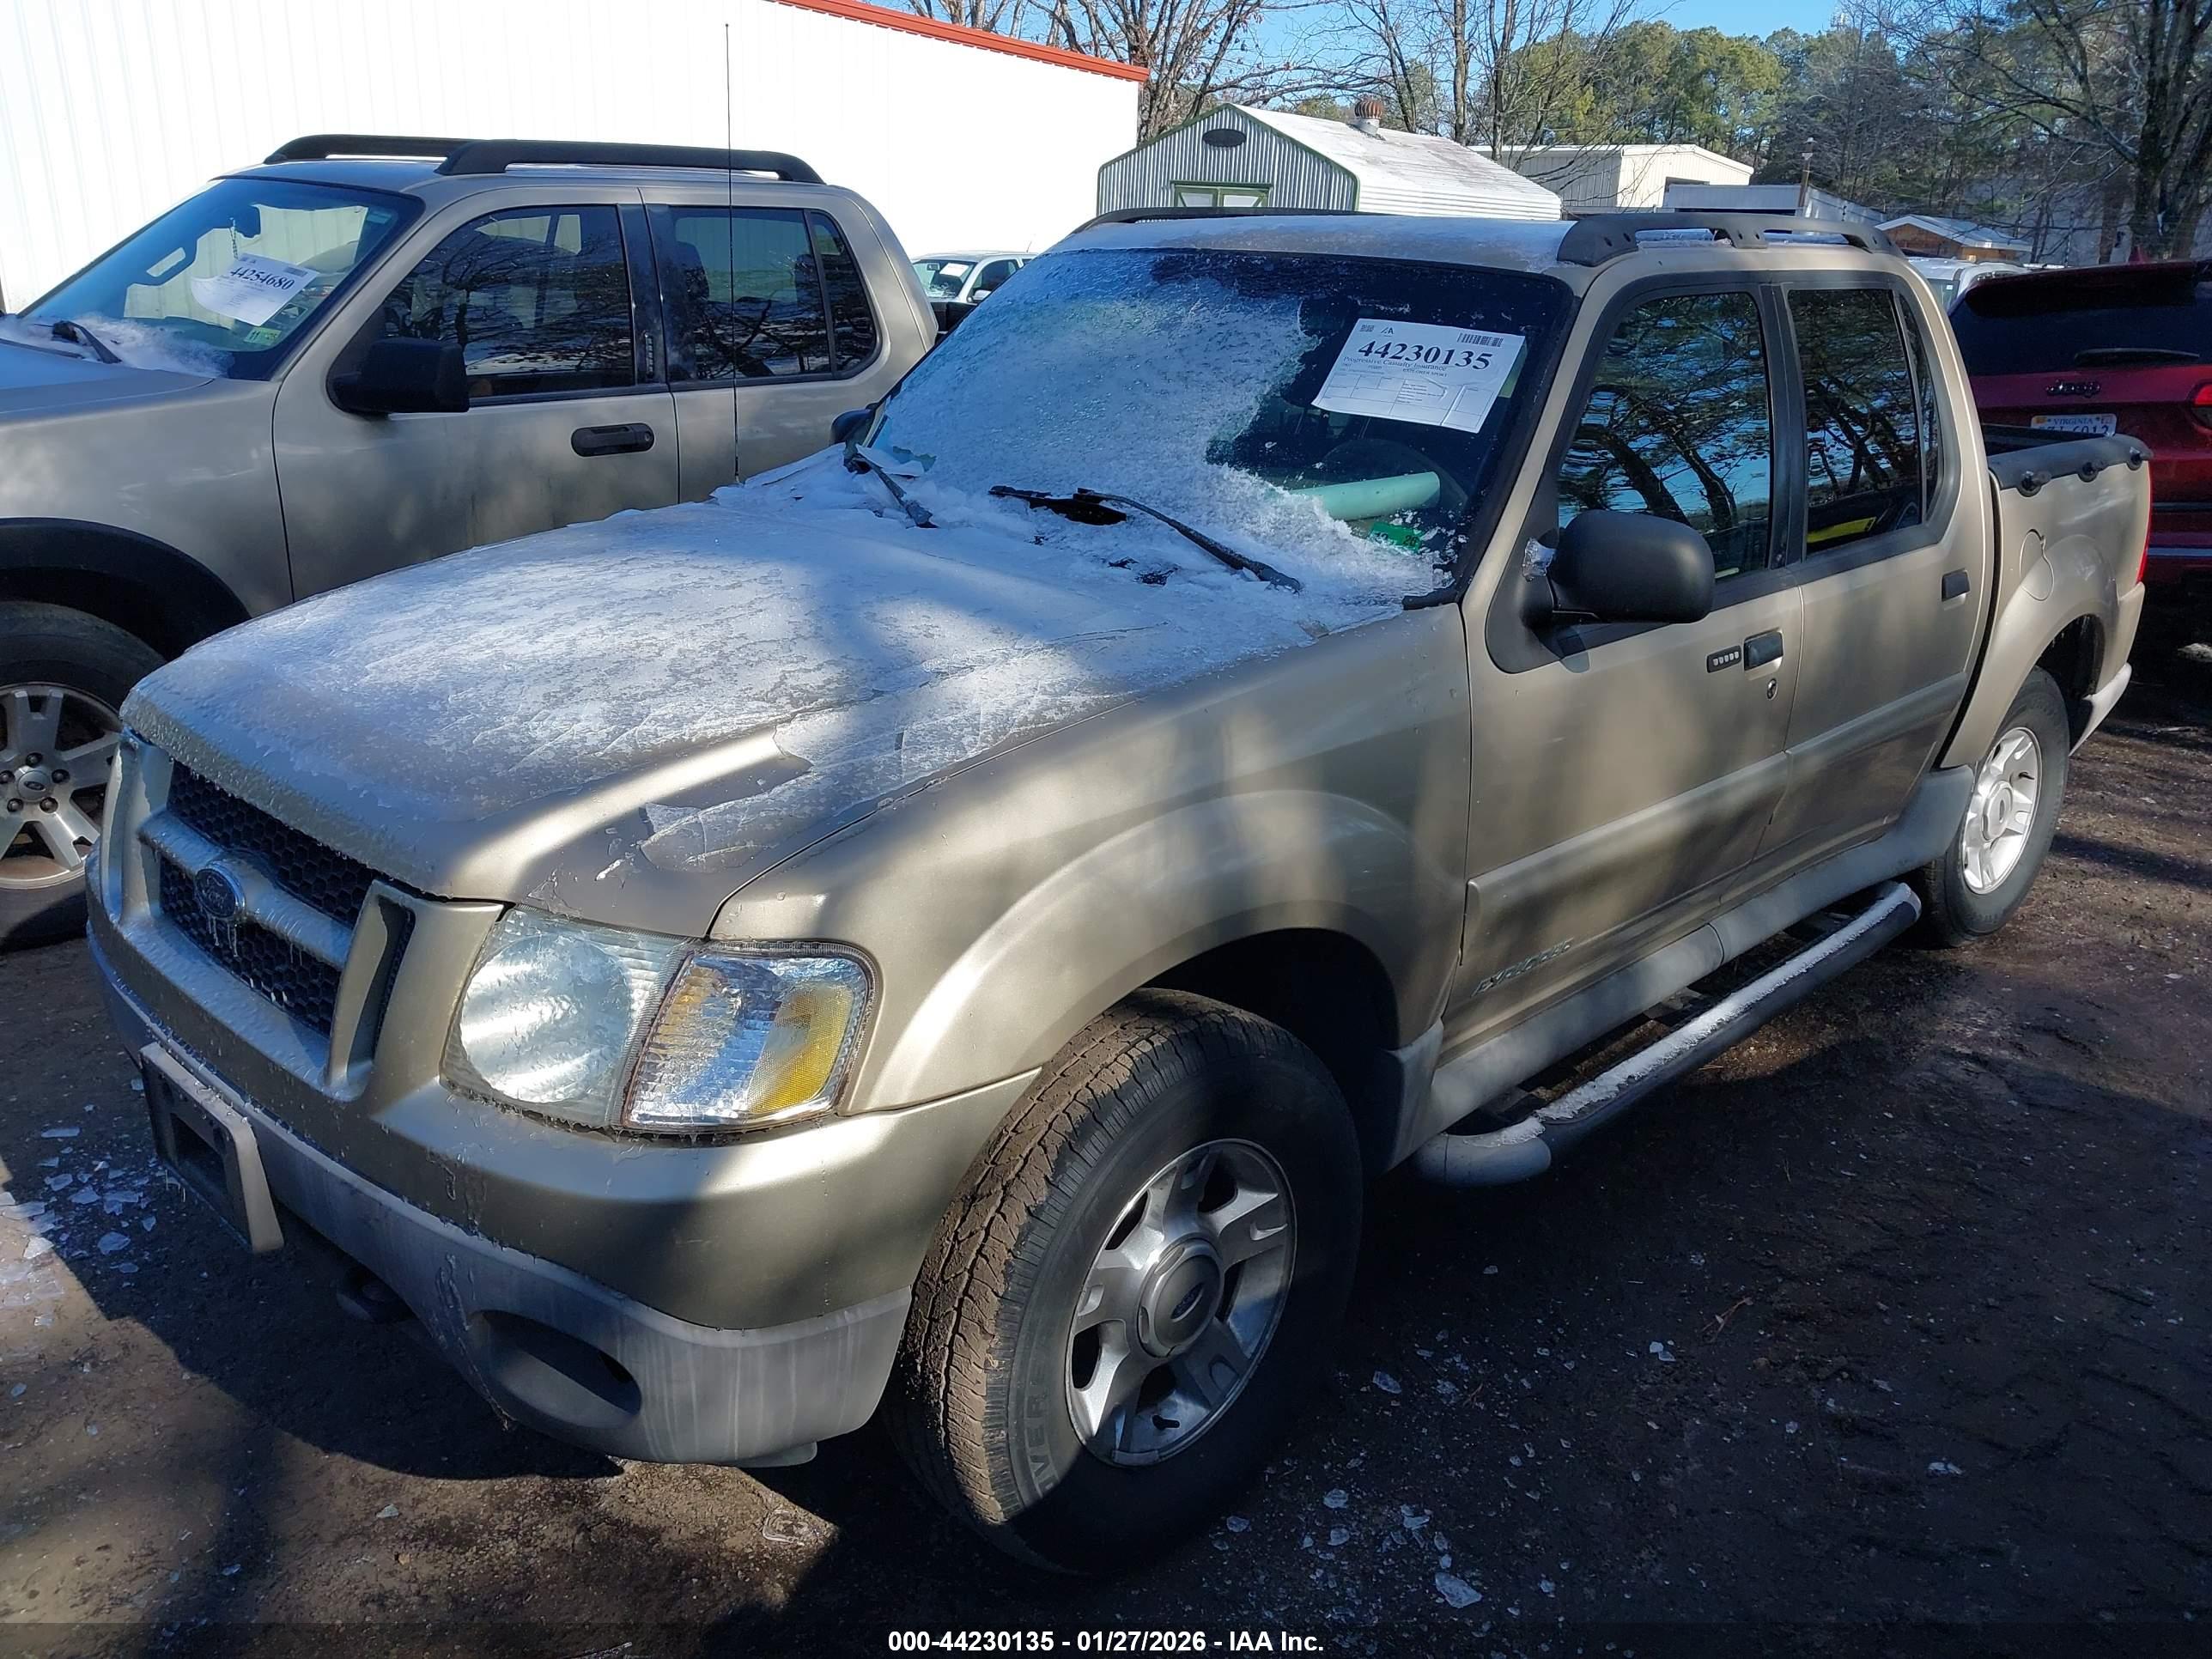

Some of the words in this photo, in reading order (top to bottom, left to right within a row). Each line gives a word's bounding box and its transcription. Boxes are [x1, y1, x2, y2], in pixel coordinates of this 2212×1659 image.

[230, 267, 295, 289] 44254680
[1343, 356, 1382, 365] Progressive
[1382, 359, 1413, 369] Casualty
[1413, 362, 1447, 372] Insurance
[1358, 340, 1492, 370] 44230135
[2045, 379, 2101, 398] Jeep
[2052, 417, 2094, 426] VIRGINIA
